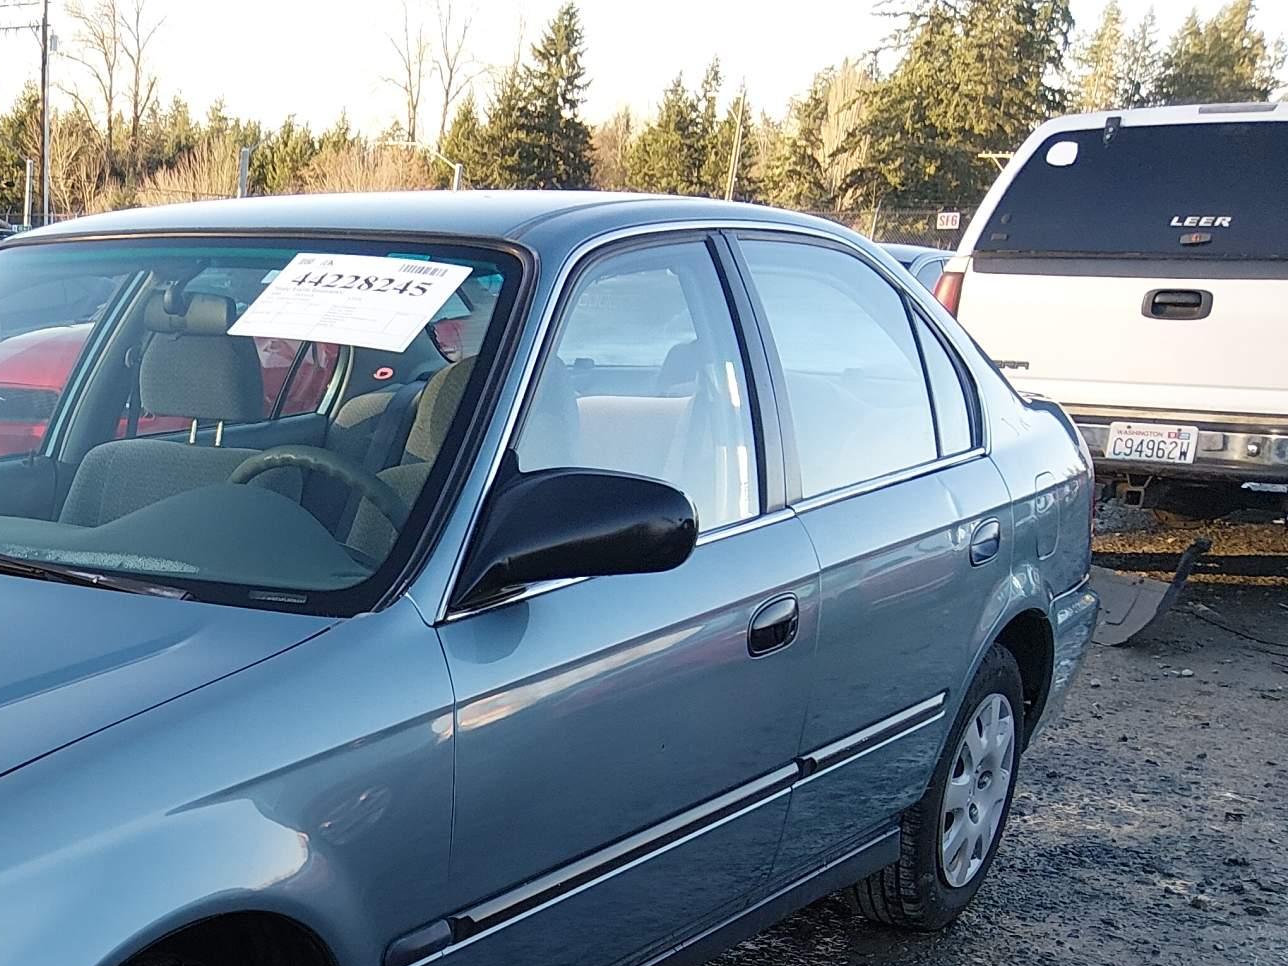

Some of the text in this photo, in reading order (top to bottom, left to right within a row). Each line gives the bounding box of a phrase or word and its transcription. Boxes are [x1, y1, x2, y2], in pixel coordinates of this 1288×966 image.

[1170, 216, 1231, 227] LEER
[291, 271, 433, 297] 44228245
[1117, 430, 1164, 438] WASHINGTON
[1112, 437, 1190, 461] C94962W
